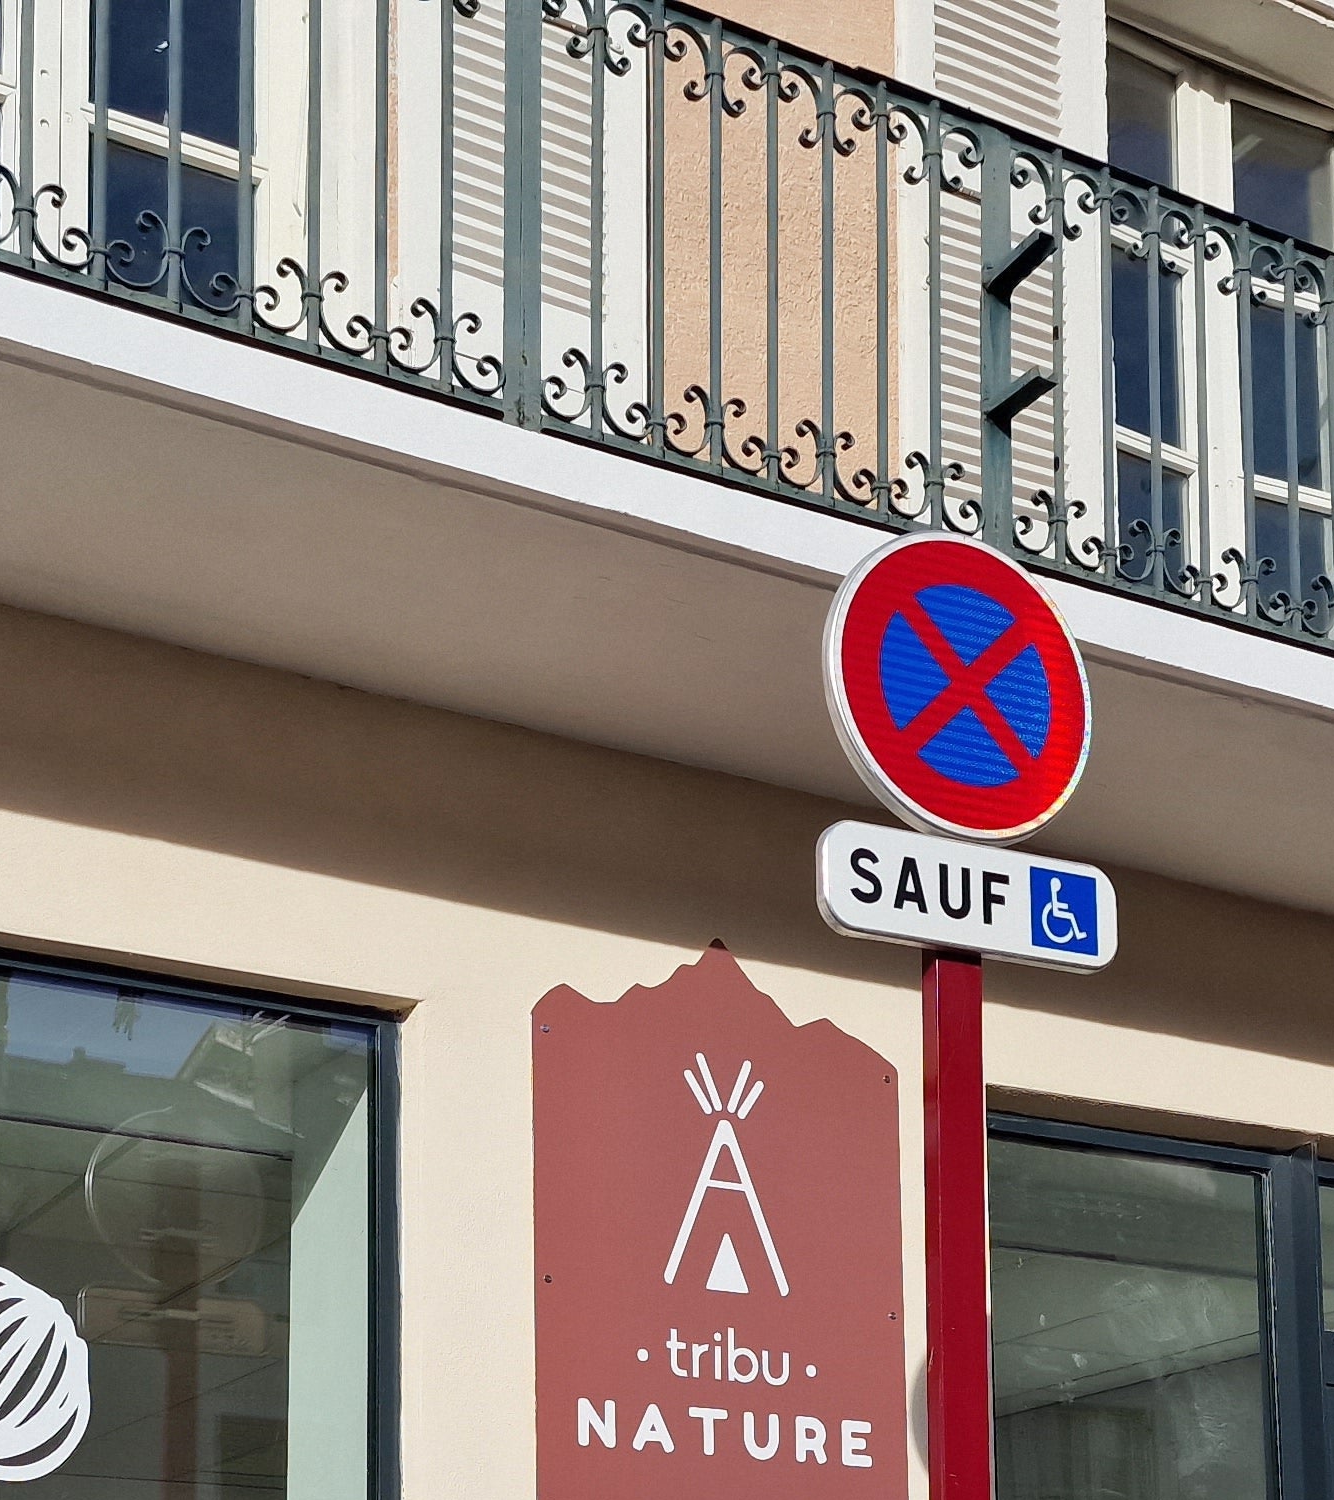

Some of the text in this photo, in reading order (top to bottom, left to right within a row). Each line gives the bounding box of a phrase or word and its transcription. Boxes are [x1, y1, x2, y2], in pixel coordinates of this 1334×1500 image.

[850, 848, 1010, 925] SAUF
[666, 1327, 790, 1386] tribu
[577, 1397, 873, 1468] NATURE
